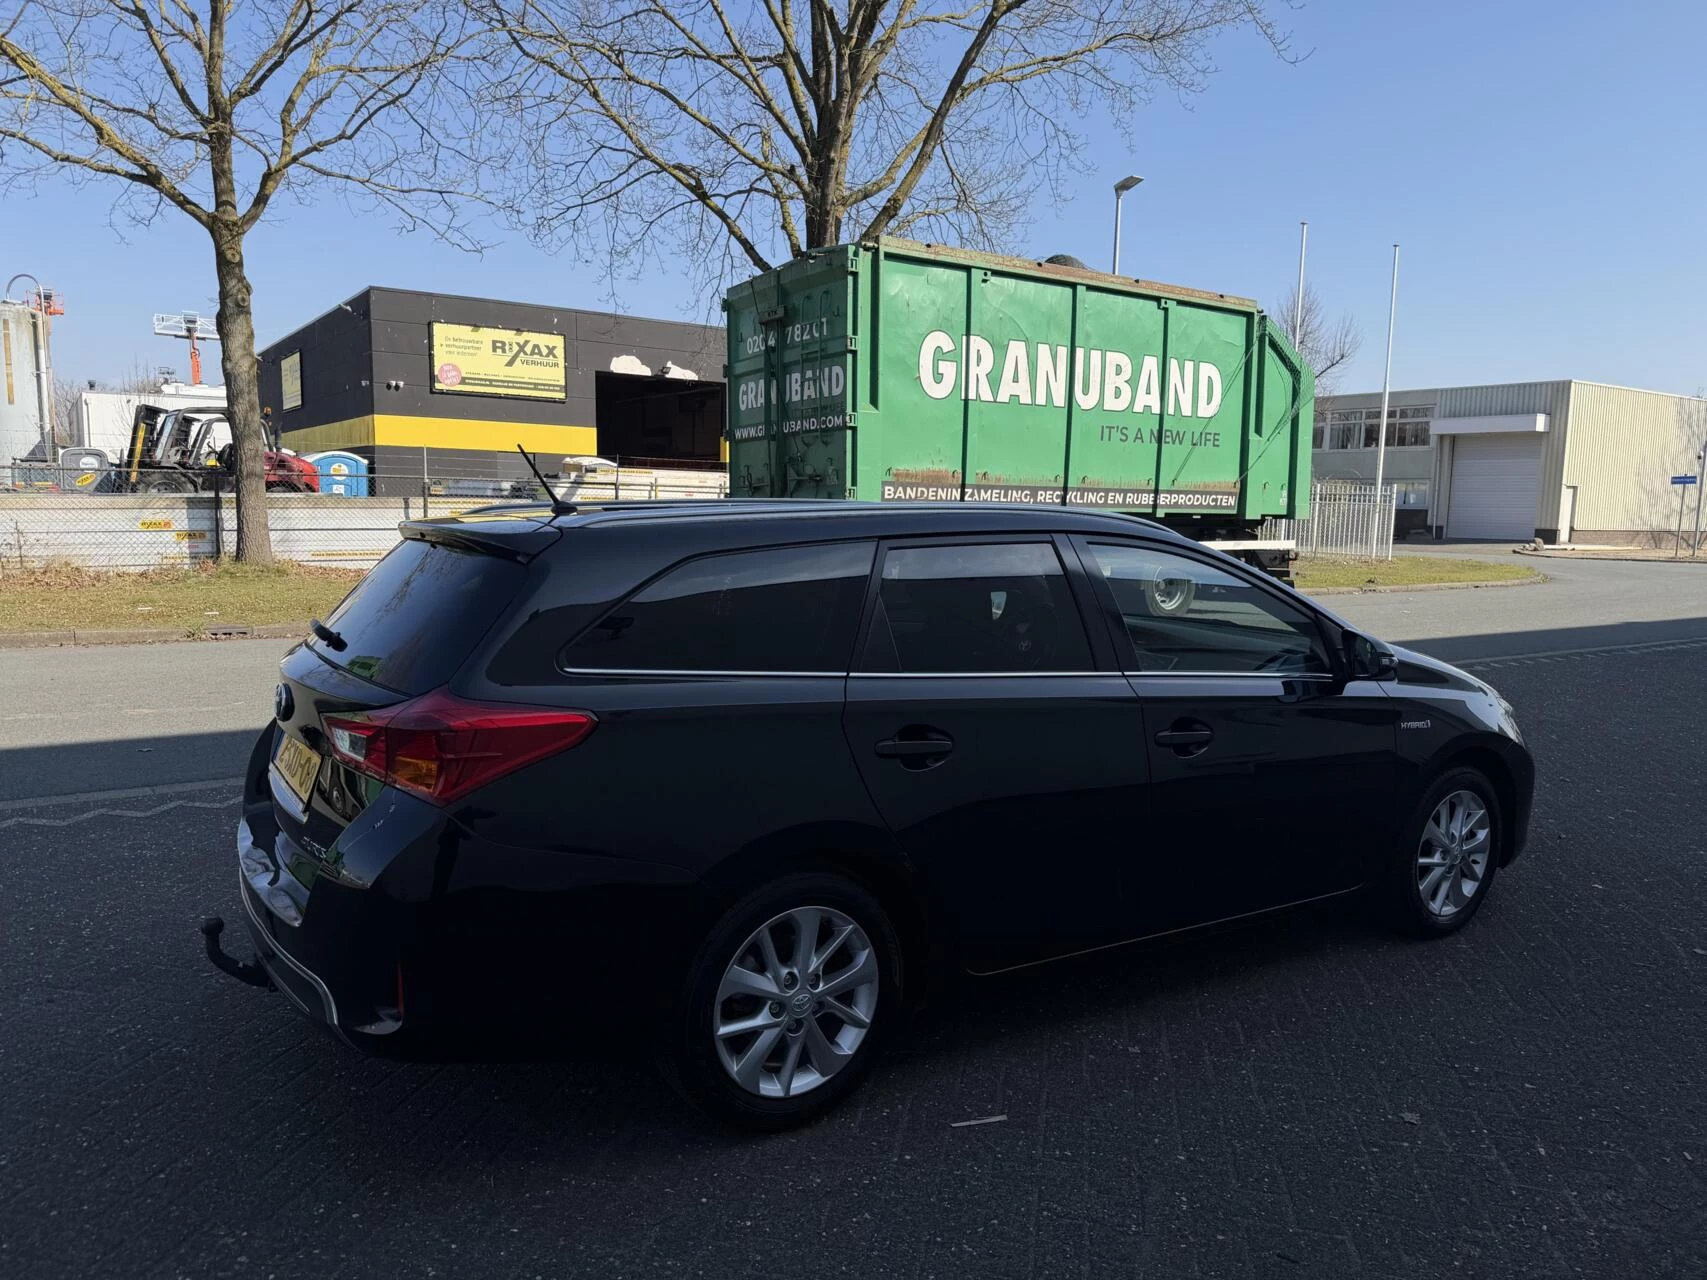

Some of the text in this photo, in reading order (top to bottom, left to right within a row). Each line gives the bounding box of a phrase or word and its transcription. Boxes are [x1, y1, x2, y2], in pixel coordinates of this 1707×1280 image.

[520, 358, 560, 369] VERHUUR
[918, 329, 1224, 418] GRANUBAND
[1100, 425, 1221, 448] IT'S A NEW LIFE
[1036, 490, 1106, 504] RECYCLING
[1107, 492, 1127, 505] EN
[1400, 720, 1428, 729] HYBRID
